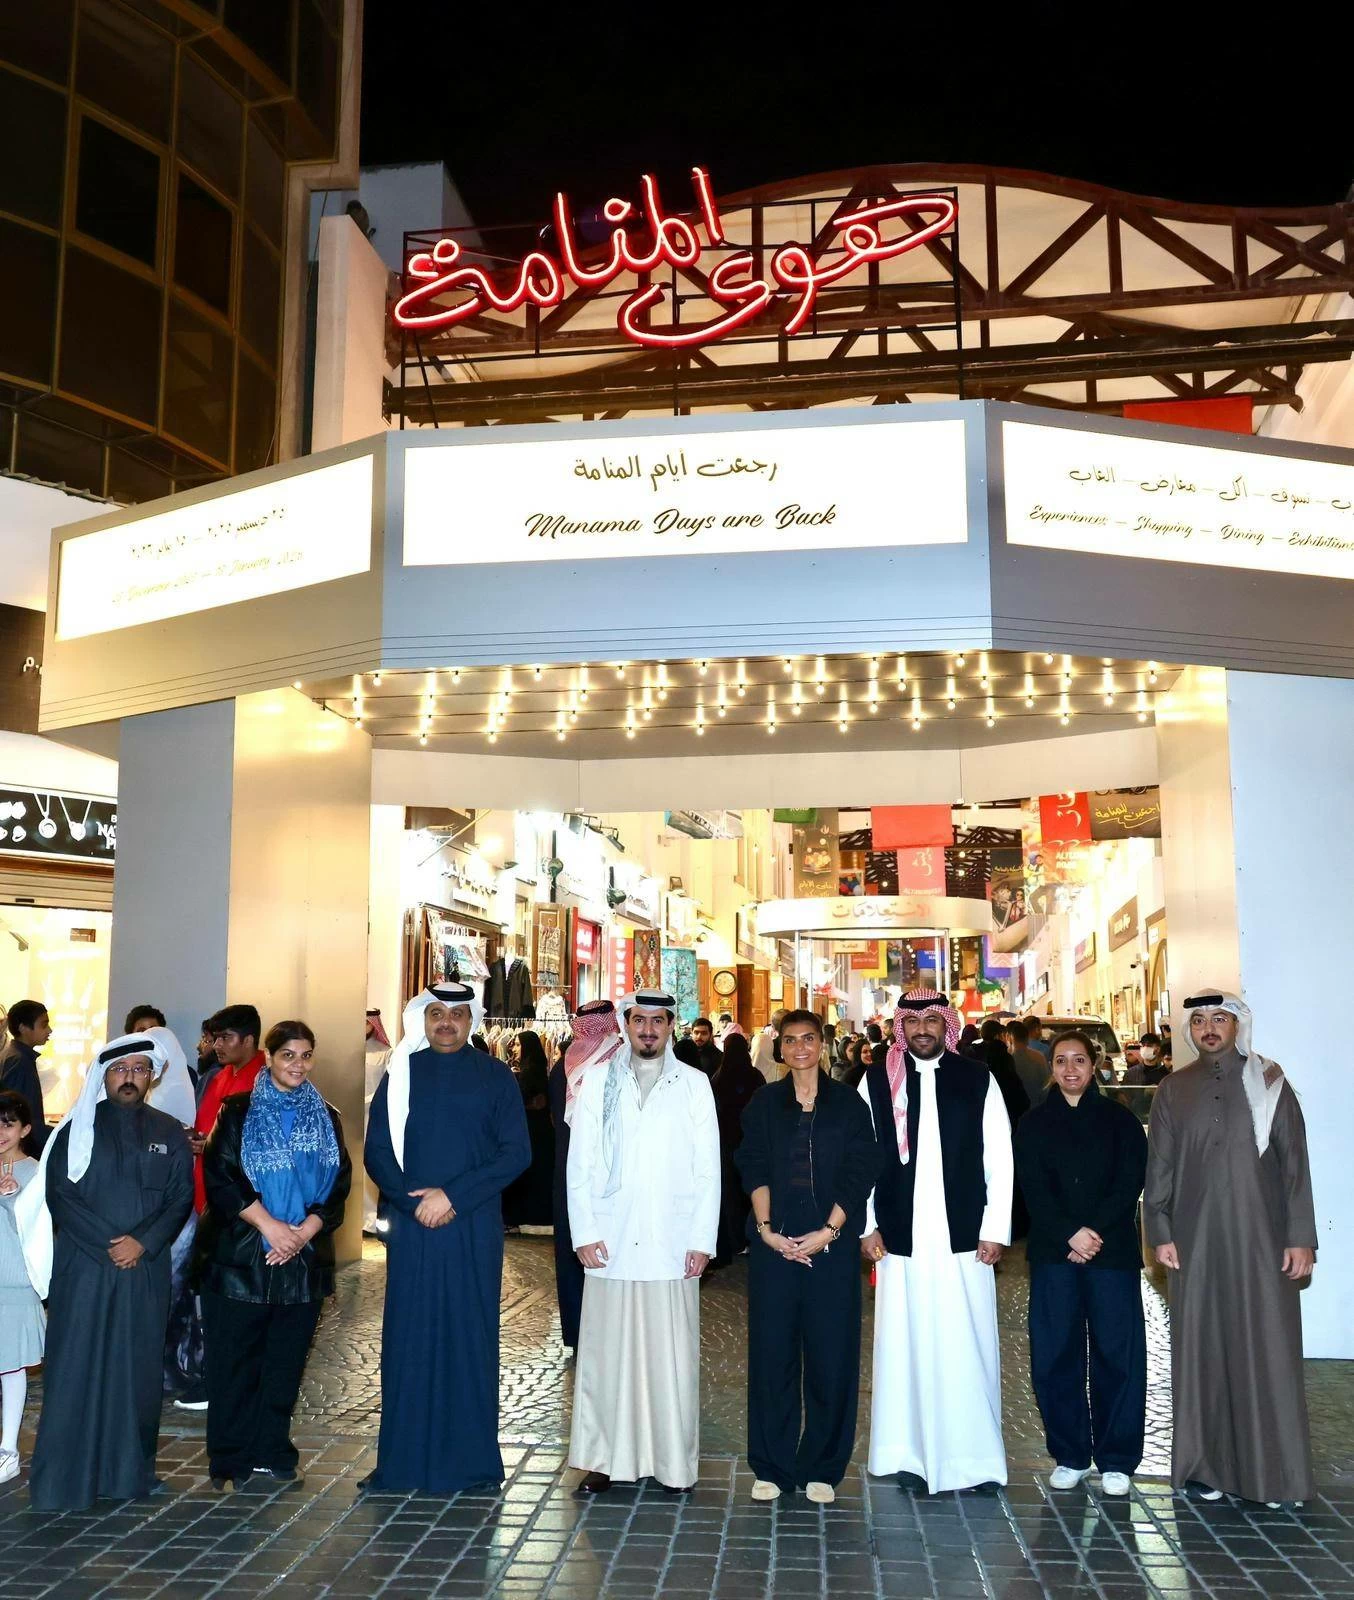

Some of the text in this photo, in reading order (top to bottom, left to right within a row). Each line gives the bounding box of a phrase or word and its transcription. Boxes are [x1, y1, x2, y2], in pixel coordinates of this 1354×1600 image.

[393, 165, 724, 327] المنامة
[573, 454, 642, 481] المنامة
[696, 456, 778, 482] رجعت
[525, 503, 837, 539] Manama Days are Back
[1028, 503, 1109, 527] Experiences
[1133, 514, 1193, 539] Shopping
[1219, 524, 1266, 545] Dining
